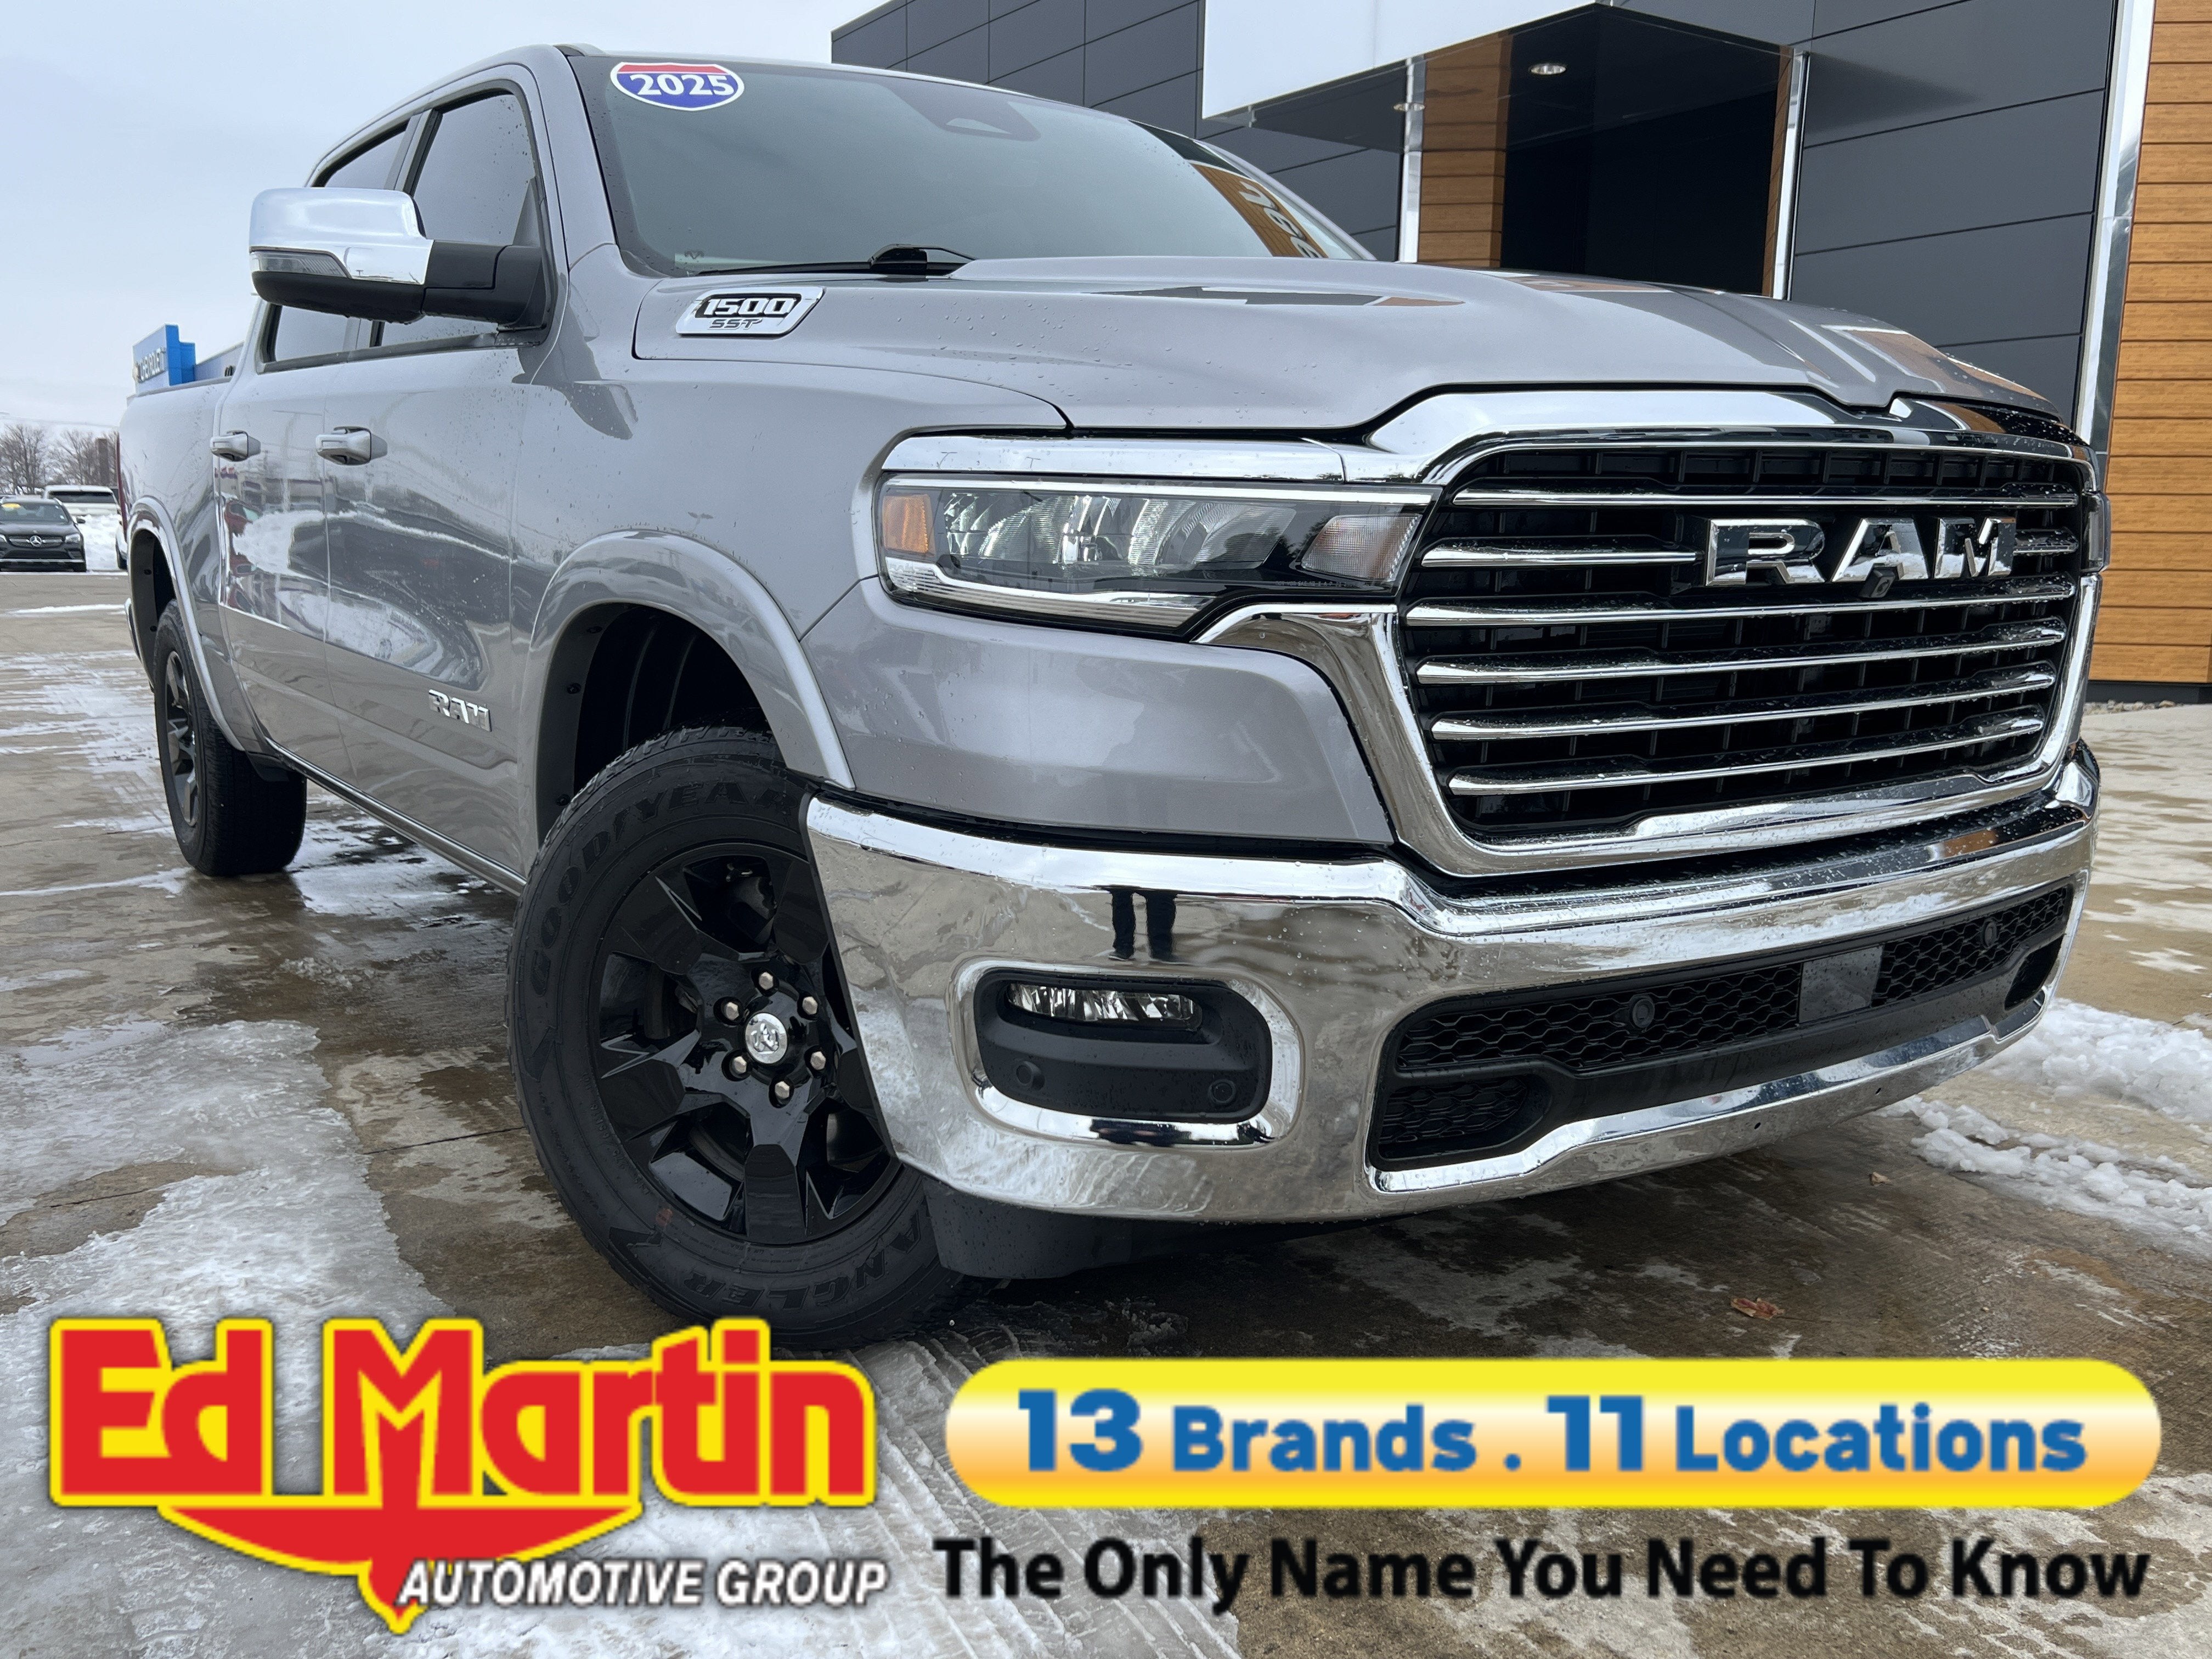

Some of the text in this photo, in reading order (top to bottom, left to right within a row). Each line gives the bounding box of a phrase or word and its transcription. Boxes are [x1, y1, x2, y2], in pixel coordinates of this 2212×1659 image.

[629, 74, 735, 95] 2025
[703, 297, 796, 316] 1500
[708, 318, 764, 330] SST
[1705, 517, 2016, 586] RAM
[428, 689, 492, 732] RAM
[529, 781, 800, 997] GOODYEAR
[683, 1209, 922, 1311] ANGLER
